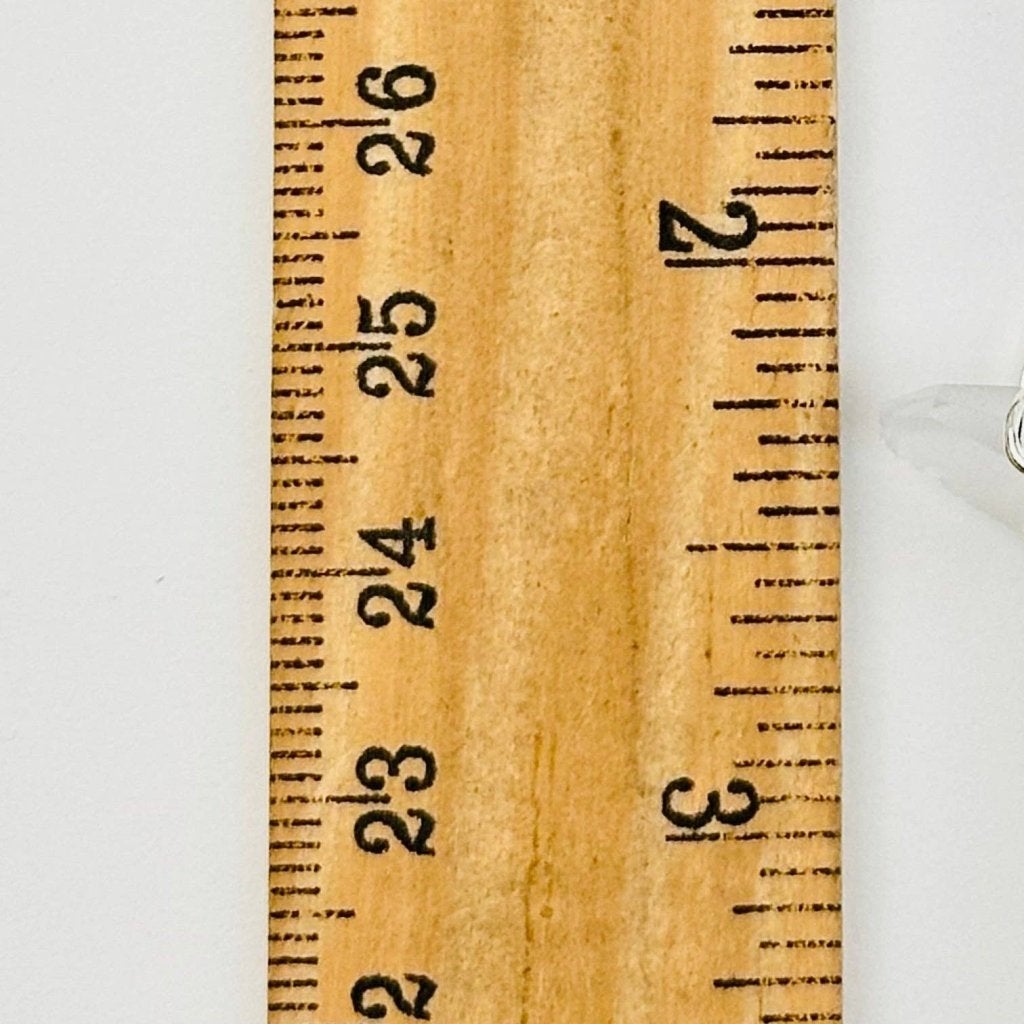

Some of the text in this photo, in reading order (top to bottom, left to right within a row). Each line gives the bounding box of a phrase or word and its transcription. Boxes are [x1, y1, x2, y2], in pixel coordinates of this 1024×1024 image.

[356, 64, 437, 176] 26
[659, 200, 759, 253] 2
[357, 291, 437, 399] 25
[357, 516, 438, 629] 24
[354, 744, 437, 856] 23
[662, 777, 760, 829] 3
